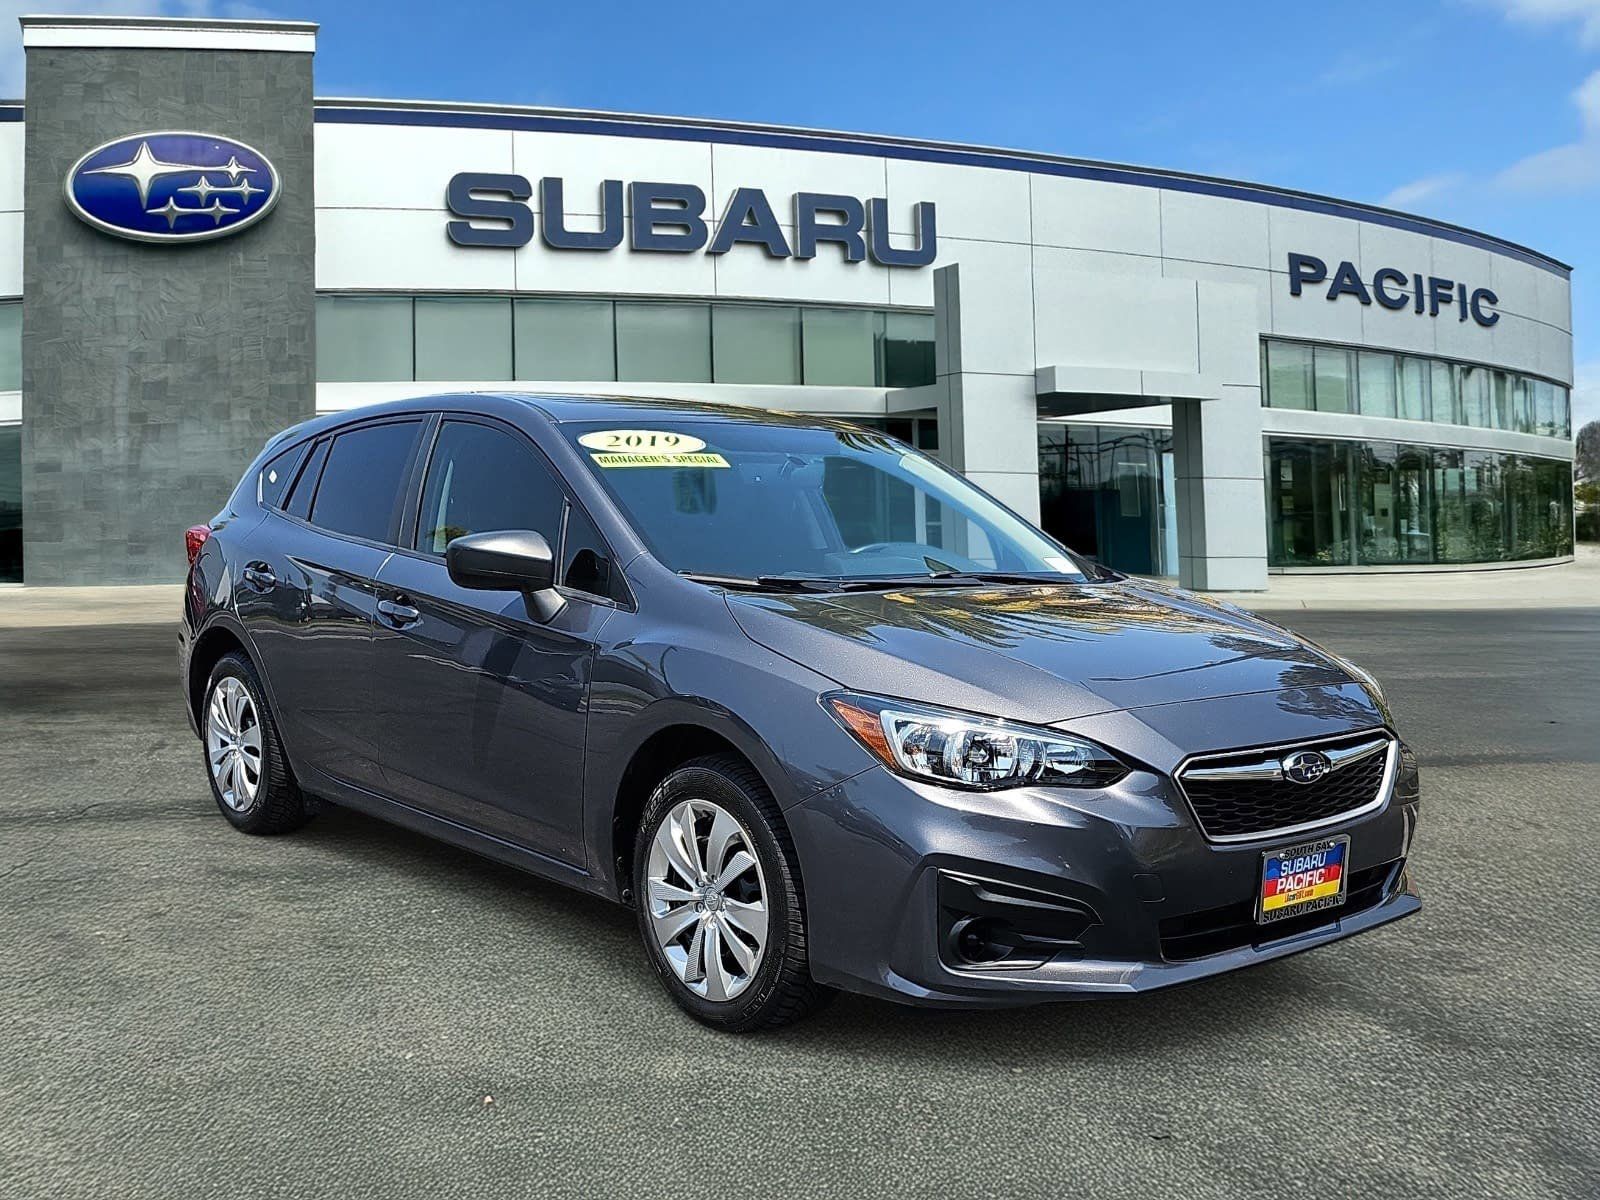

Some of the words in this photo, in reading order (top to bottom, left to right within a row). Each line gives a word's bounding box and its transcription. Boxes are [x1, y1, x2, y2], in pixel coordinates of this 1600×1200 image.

[446, 172, 938, 267] SUBARU
[1288, 252, 1500, 327] PACIFIC
[607, 434, 681, 447] 2019
[598, 455, 669, 464] MANAGER'S
[672, 455, 721, 464] SPECIAL
[1280, 852, 1327, 877] SUBARU
[1284, 845, 1314, 859] SOUTH
[1276, 869, 1325, 894] PACIFIC
[1263, 904, 1305, 921] SUBARU
[1306, 894, 1344, 912] PACIFIC
